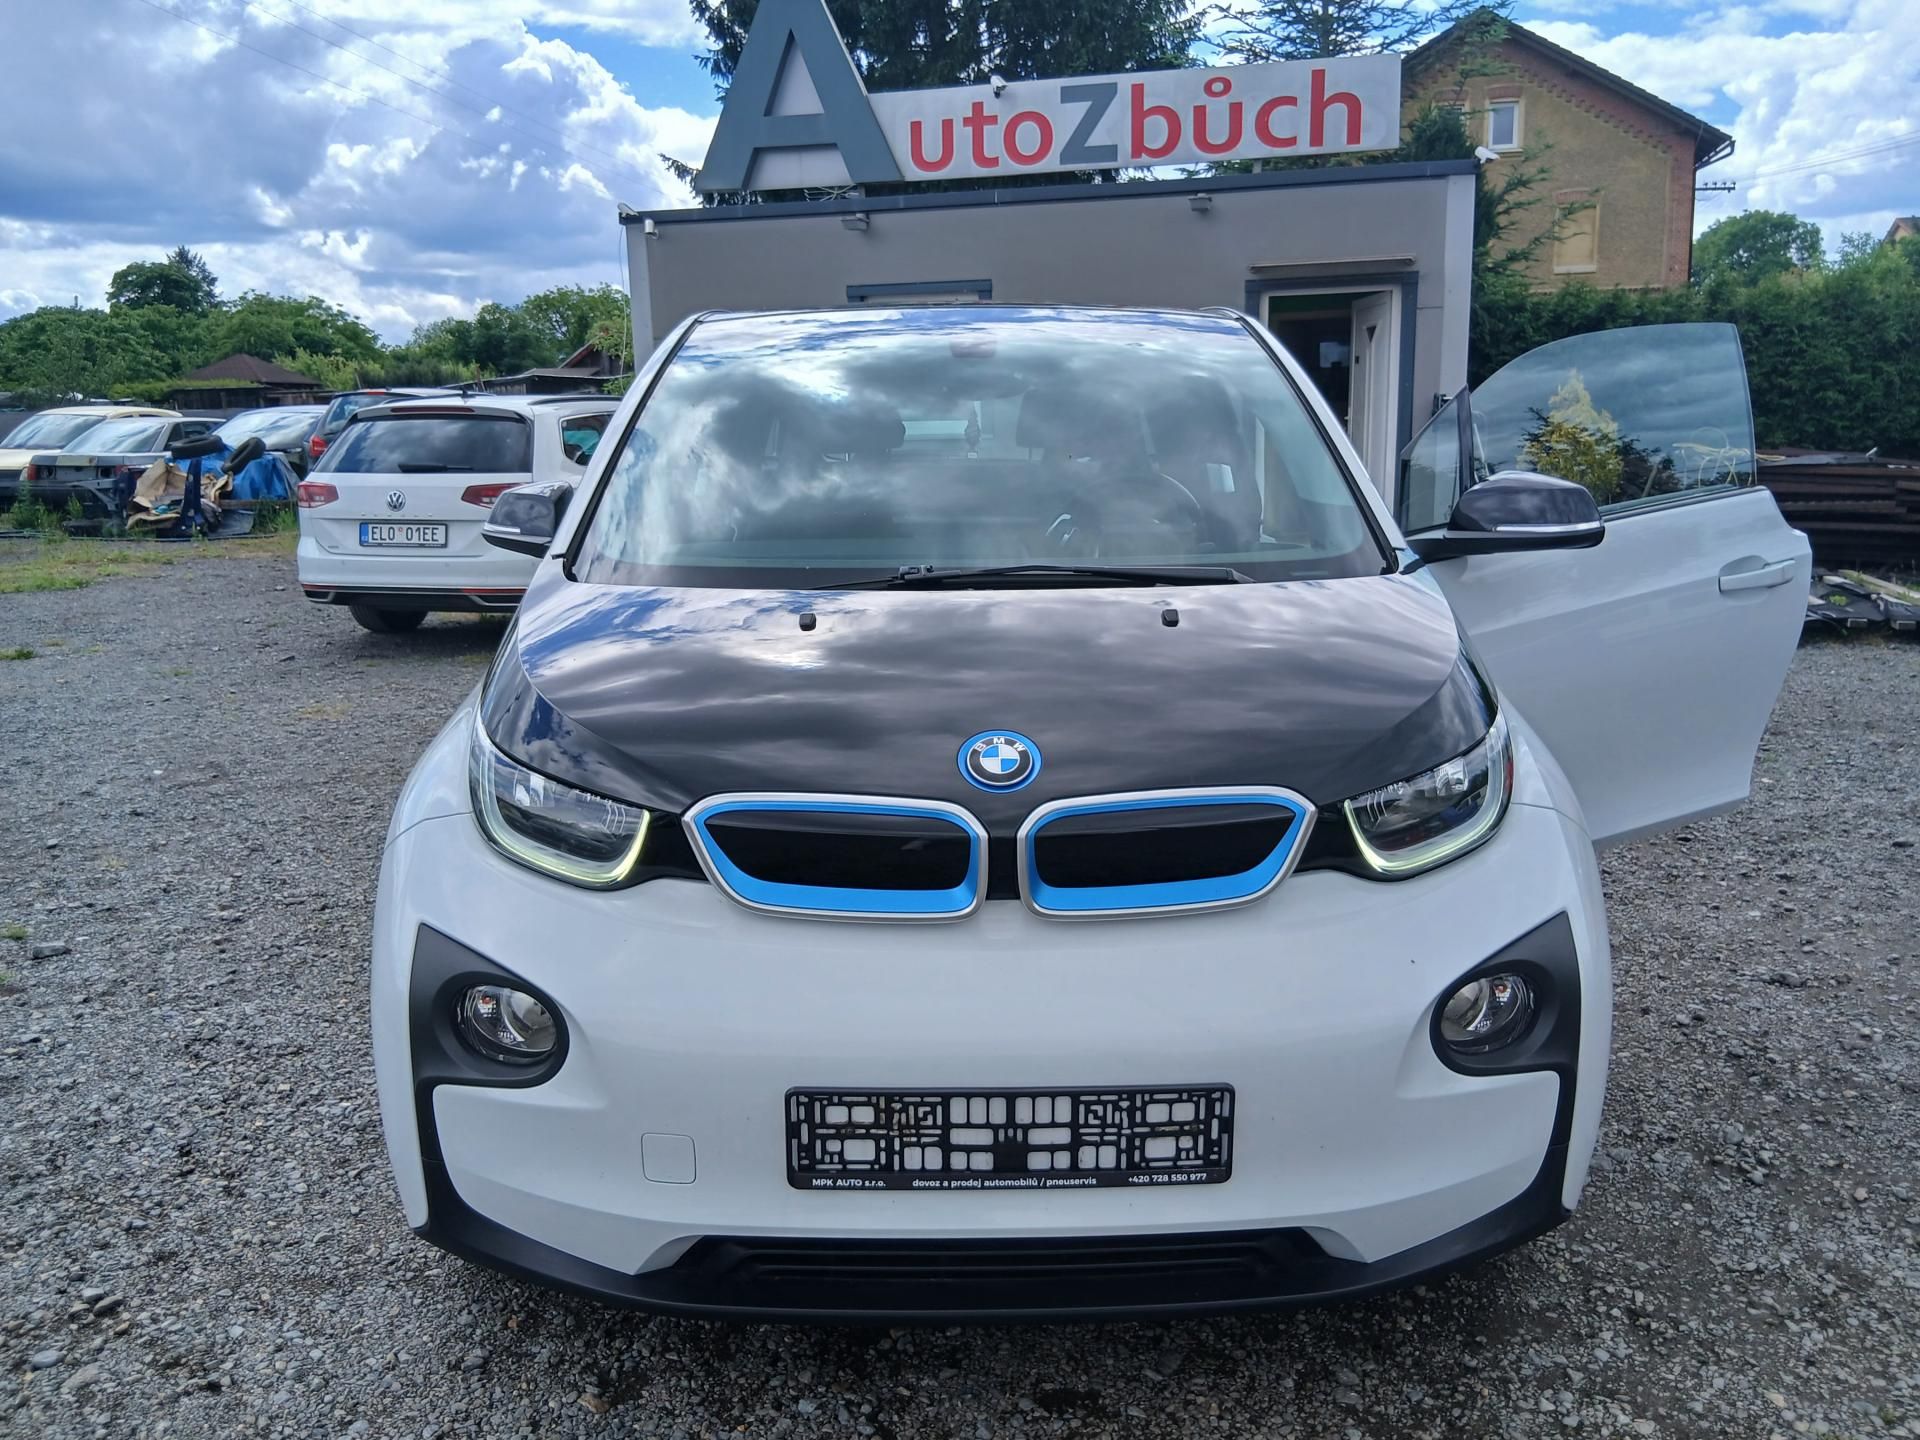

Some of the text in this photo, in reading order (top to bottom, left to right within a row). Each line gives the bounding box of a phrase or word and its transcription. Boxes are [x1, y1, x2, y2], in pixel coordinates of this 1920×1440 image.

[974, 737, 1026, 752] BMW
[812, 1178, 833, 1187] MPK
[836, 1178, 863, 1187] AUTO
[912, 1178, 940, 1187] dovoz
[951, 1177, 981, 1189] prodej
[983, 1176, 1038, 1187] automobilů
[1046, 1176, 1097, 1187] pneuservis
[1128, 1174, 1150, 1183] +420
[1152, 1174, 1169, 1183] 728
[1171, 1173, 1188, 1182] 550
[1190, 1173, 1207, 1181] 977
